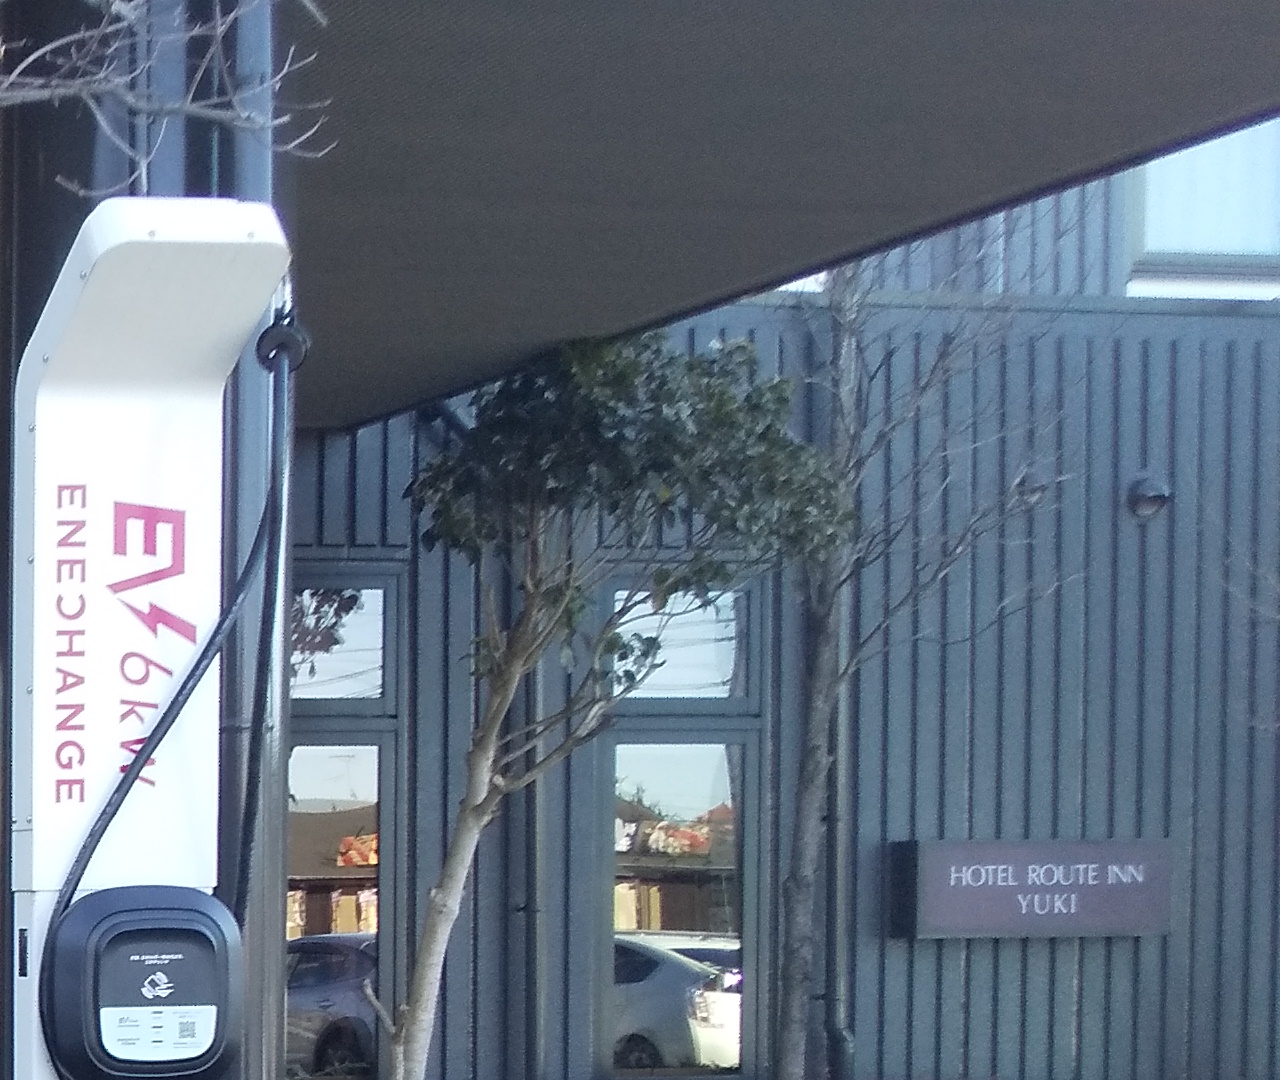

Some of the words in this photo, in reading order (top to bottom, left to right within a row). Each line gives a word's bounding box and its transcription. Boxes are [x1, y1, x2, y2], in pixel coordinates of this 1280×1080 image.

[105, 501, 197, 645] EV
[950, 865, 1018, 887] HOTEL
[1026, 864, 1100, 886] ROUTE
[1107, 865, 1144, 884] INN
[1017, 893, 1078, 915] YUKI
